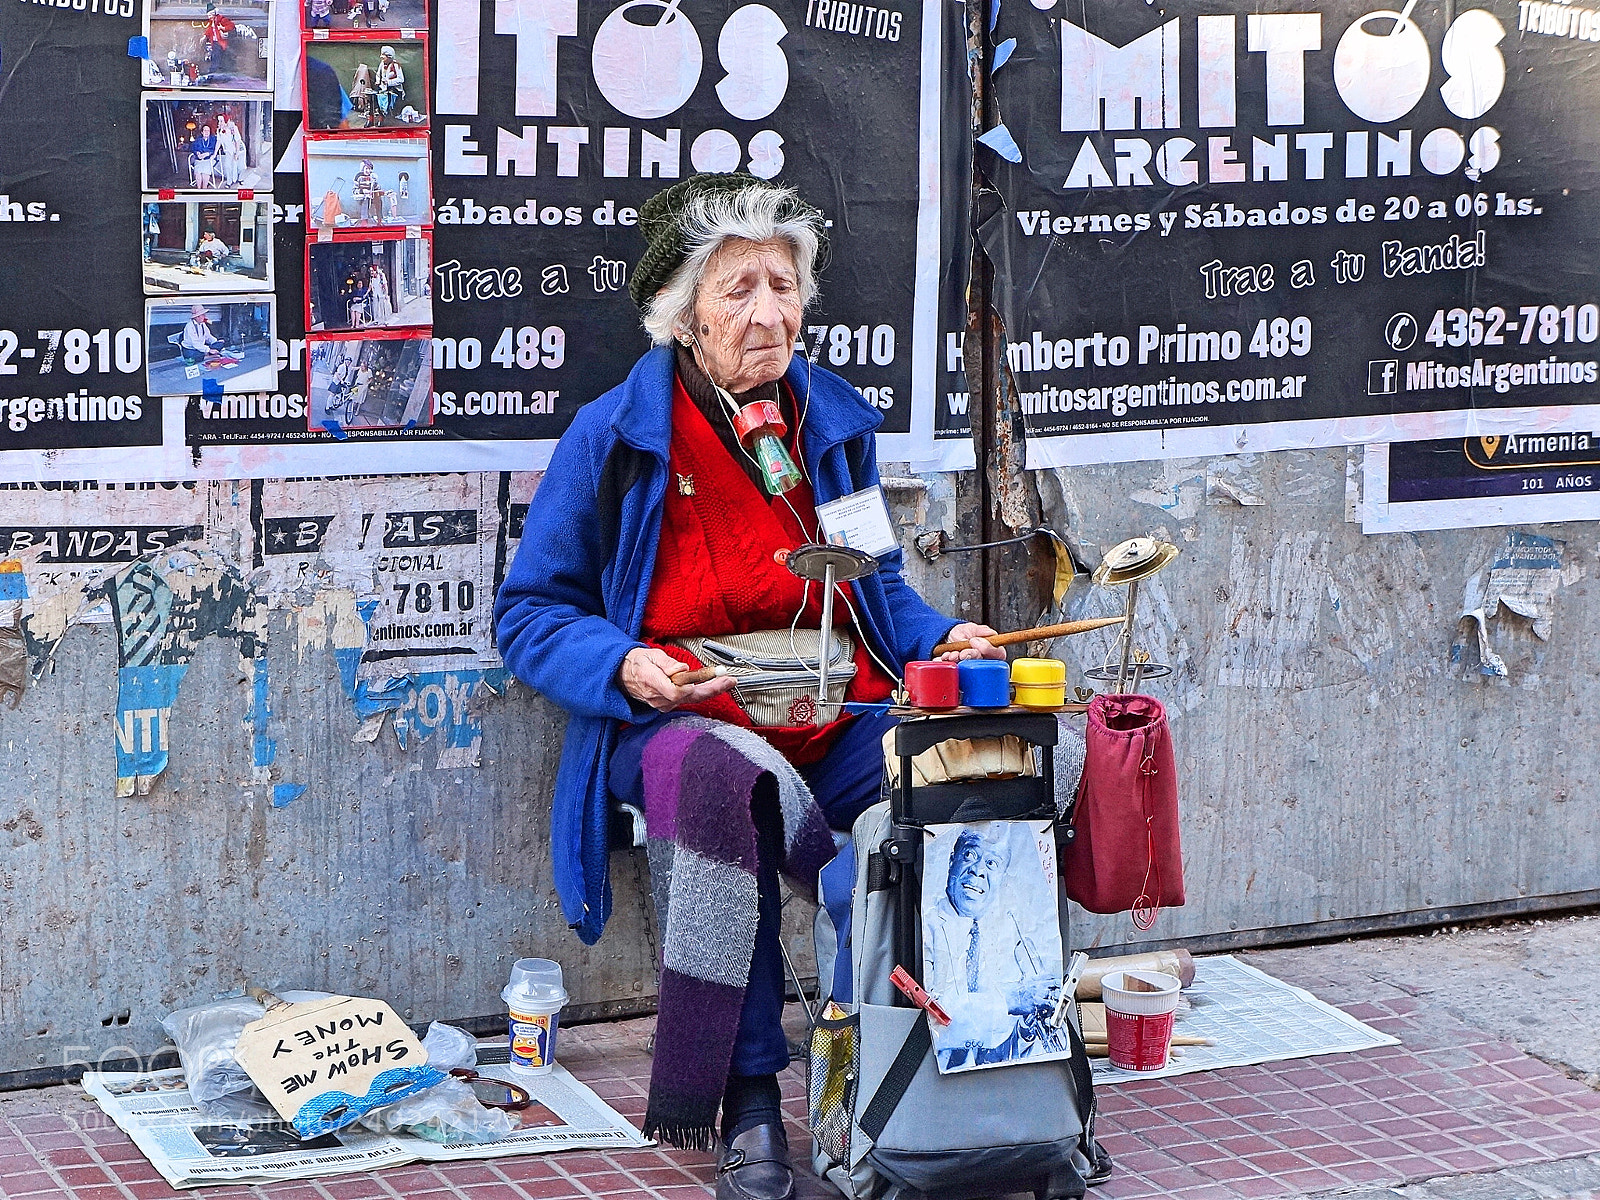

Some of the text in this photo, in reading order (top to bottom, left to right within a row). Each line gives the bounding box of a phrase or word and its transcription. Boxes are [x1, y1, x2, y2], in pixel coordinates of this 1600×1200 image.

[804, 0, 903, 43] TRIBUTOS
[1517, 0, 1600, 42] TRIBUTOS
[275, 0, 790, 120] ITOS
[1060, 8, 1507, 132] MITOS
[1062, 126, 1501, 189] ARGENTINOS
[0, 194, 61, 222] hs.
[432, 198, 638, 227] ábados de
[1018, 192, 1543, 237] Viernes y Sábados de 20 a 06 hs.
[434, 255, 627, 303] Trae a tu
[1200, 229, 1487, 300] Trae a tu Banda!
[490, 325, 566, 370] 489
[793, 324, 896, 366] -7810
[946, 315, 1313, 373] Hmberto Primo 489
[1425, 303, 1600, 348] 4362-7810
[1406, 355, 1599, 393] MitosArgentinos
[345, 429, 398, 438] ESPONSABILIZA
[1504, 433, 1589, 455] Armenia
[1522, 474, 1592, 490] 101 AÑOS
[8, 530, 170, 557] BANDAS
[271, 1011, 384, 1059] MONEY
[280, 1039, 409, 1095] SHOW ME
